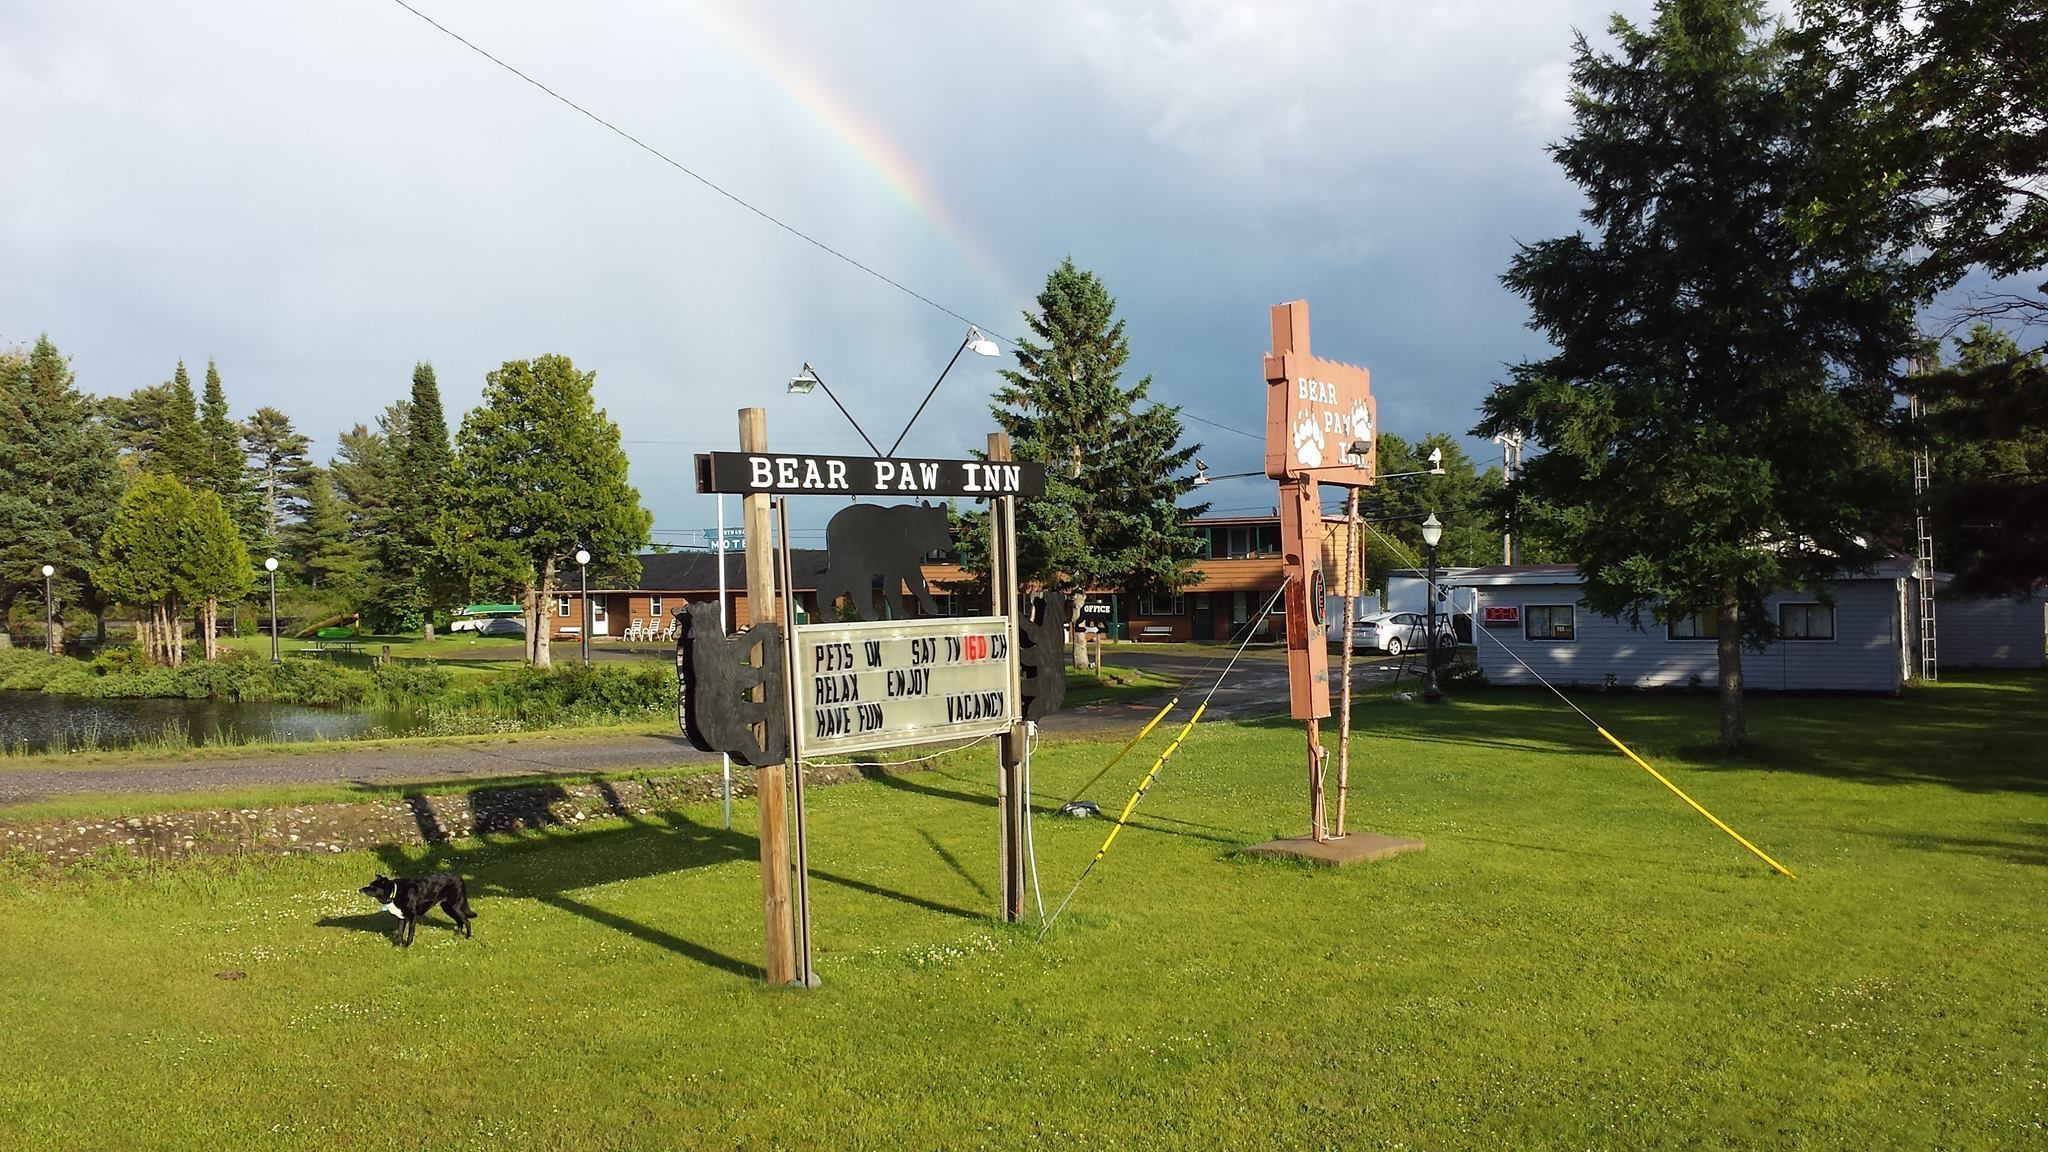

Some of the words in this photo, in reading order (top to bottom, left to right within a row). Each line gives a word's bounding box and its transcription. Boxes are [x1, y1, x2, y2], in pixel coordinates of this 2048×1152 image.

[1298, 377, 1338, 405] BEAR
[749, 457, 850, 490] BEAR
[873, 461, 939, 491] PAW
[961, 463, 1021, 492] INN
[711, 540, 747, 549] MOTE
[1084, 605, 1111, 613] OFFICE
[1485, 607, 1518, 620] OPEN
[816, 643, 853, 672] PETS
[865, 640, 882, 667] OK
[912, 637, 936, 666] SAT
[945, 636, 961, 663] TV
[991, 634, 1007, 659] CH
[815, 673, 859, 705] RELAX
[887, 668, 930, 696] ENJOY
[816, 706, 850, 737] HAVE
[857, 703, 884, 732] FUN
[946, 691, 1004, 722] VACANCY
